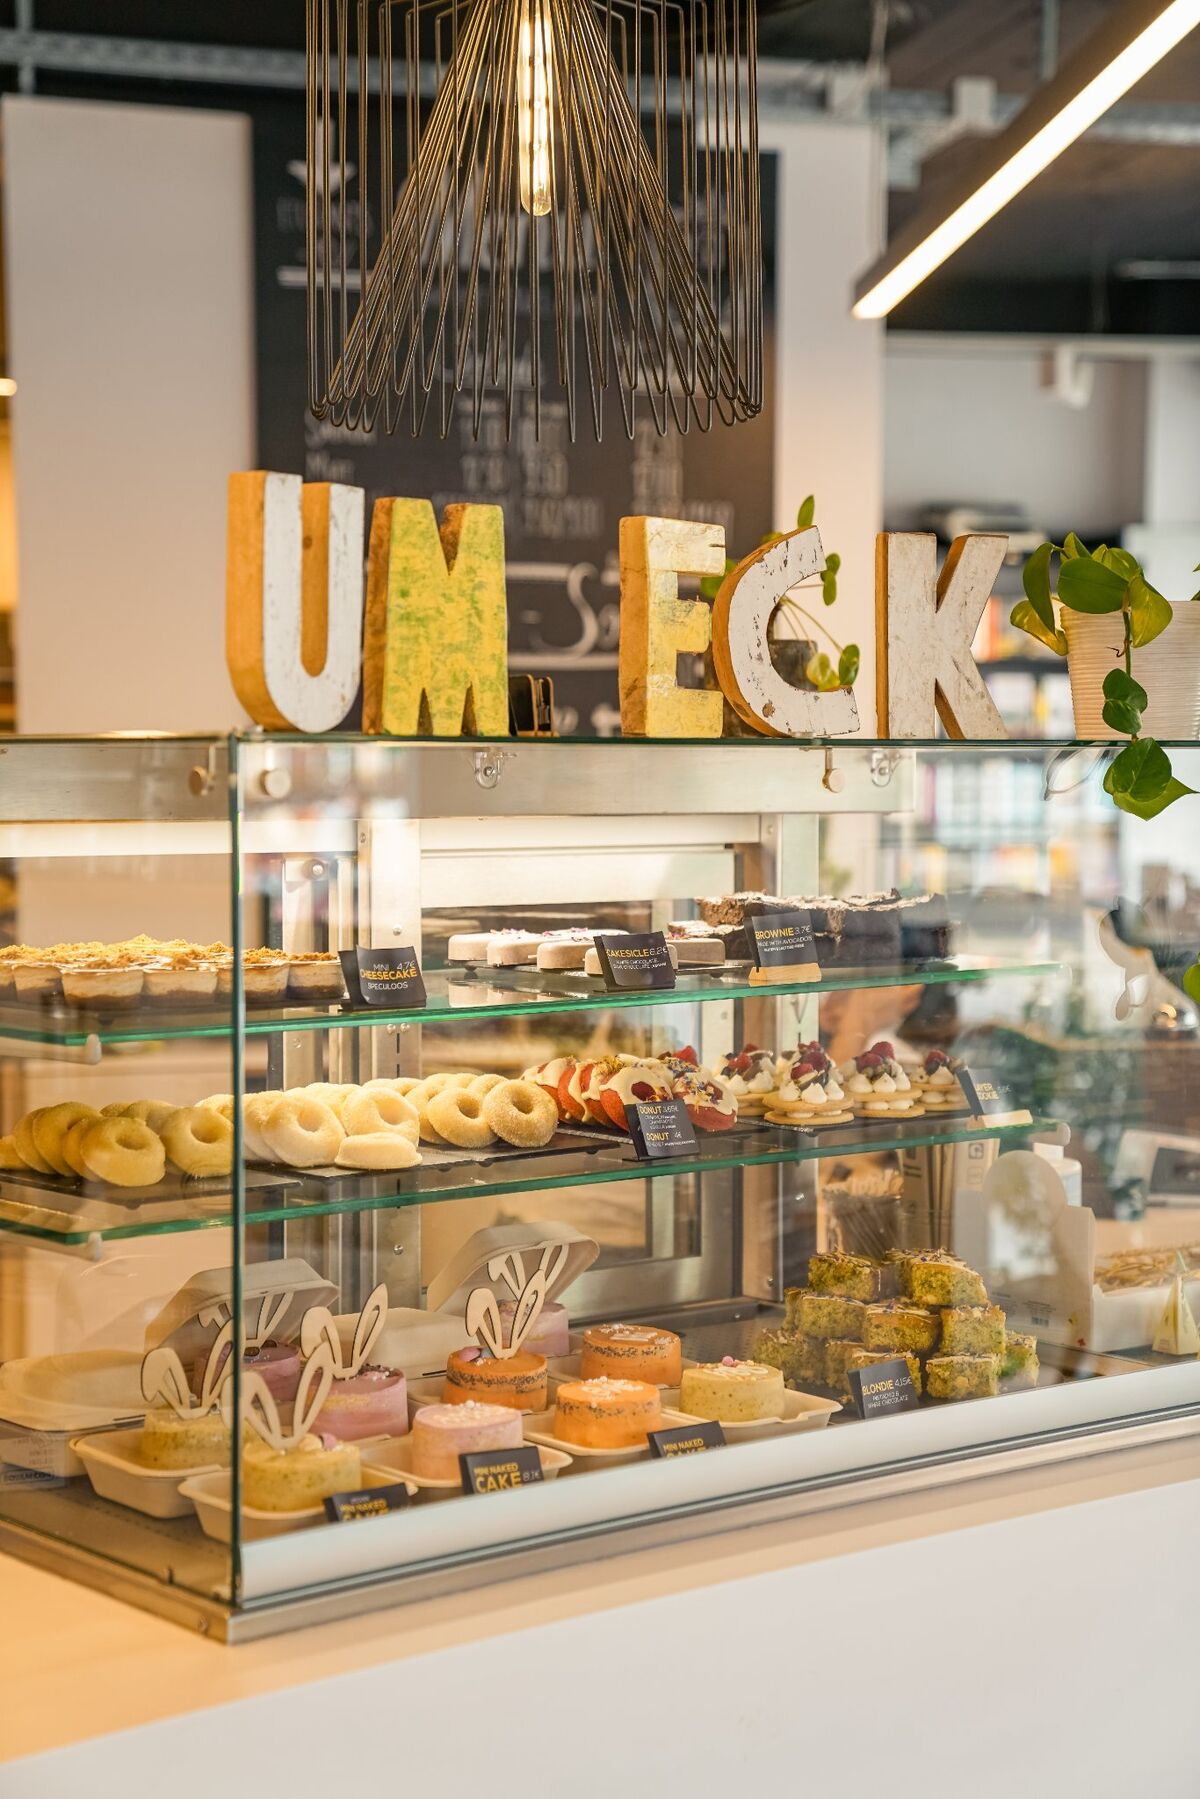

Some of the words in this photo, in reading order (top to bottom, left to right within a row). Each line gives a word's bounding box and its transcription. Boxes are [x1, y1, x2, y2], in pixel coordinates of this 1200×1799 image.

[226, 470, 509, 736] UM
[618, 516, 1010, 740] ECK
[755, 928, 794, 940] BROWNIE
[367, 981, 409, 991] SPECULOOS
[639, 1106, 662, 1115] DONUT
[646, 1132, 670, 1142] DONUT
[861, 1380, 895, 1396] BLONDIE
[678, 1438, 704, 1450] NAKED
[488, 1462, 519, 1473] NAKED
[476, 1471, 523, 1493] CAKE
